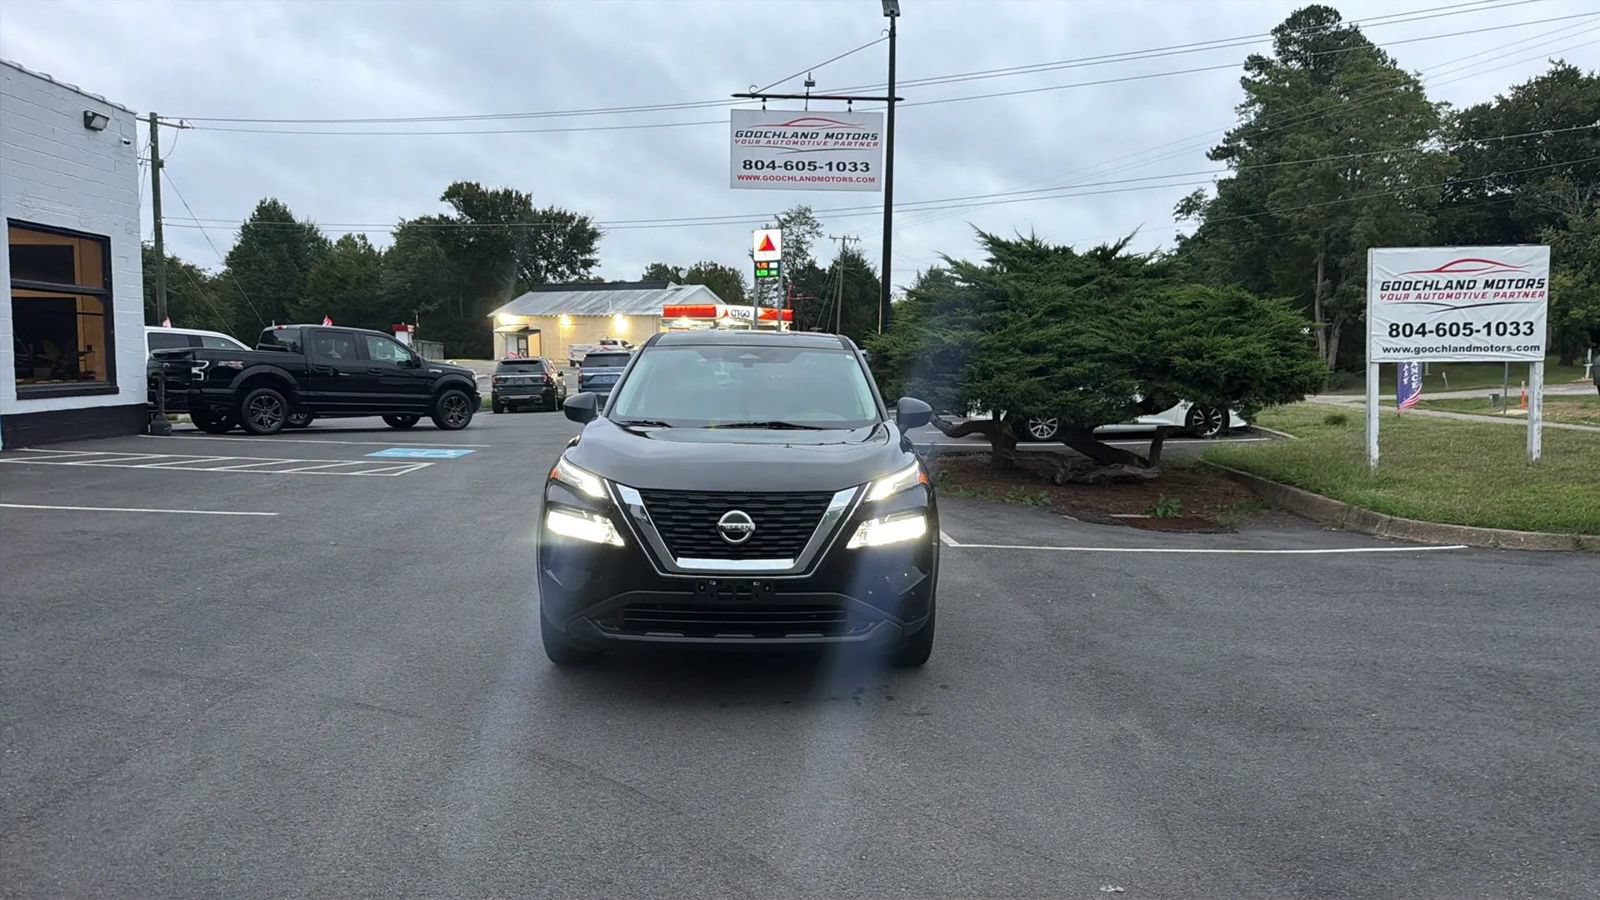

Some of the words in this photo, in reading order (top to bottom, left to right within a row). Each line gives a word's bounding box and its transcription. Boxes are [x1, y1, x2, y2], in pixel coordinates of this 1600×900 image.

[735, 130, 820, 139] GOOCHLAND
[824, 132, 879, 140] MOTORS
[742, 159, 870, 172] 804-605-1033
[736, 174, 876, 183] WWW.GOOCHLANDMOTORS.COM
[1380, 279, 1477, 291] GOOCHLAND
[1483, 278, 1546, 289] MOTORS
[1379, 293, 1410, 301] YOUR
[1415, 292, 1489, 300] AUTOMOTIVE
[1493, 291, 1546, 299] PARTNER
[1388, 321, 1535, 338] 804-605-1033
[1382, 344, 1541, 355] www.goochlandmotors.com
